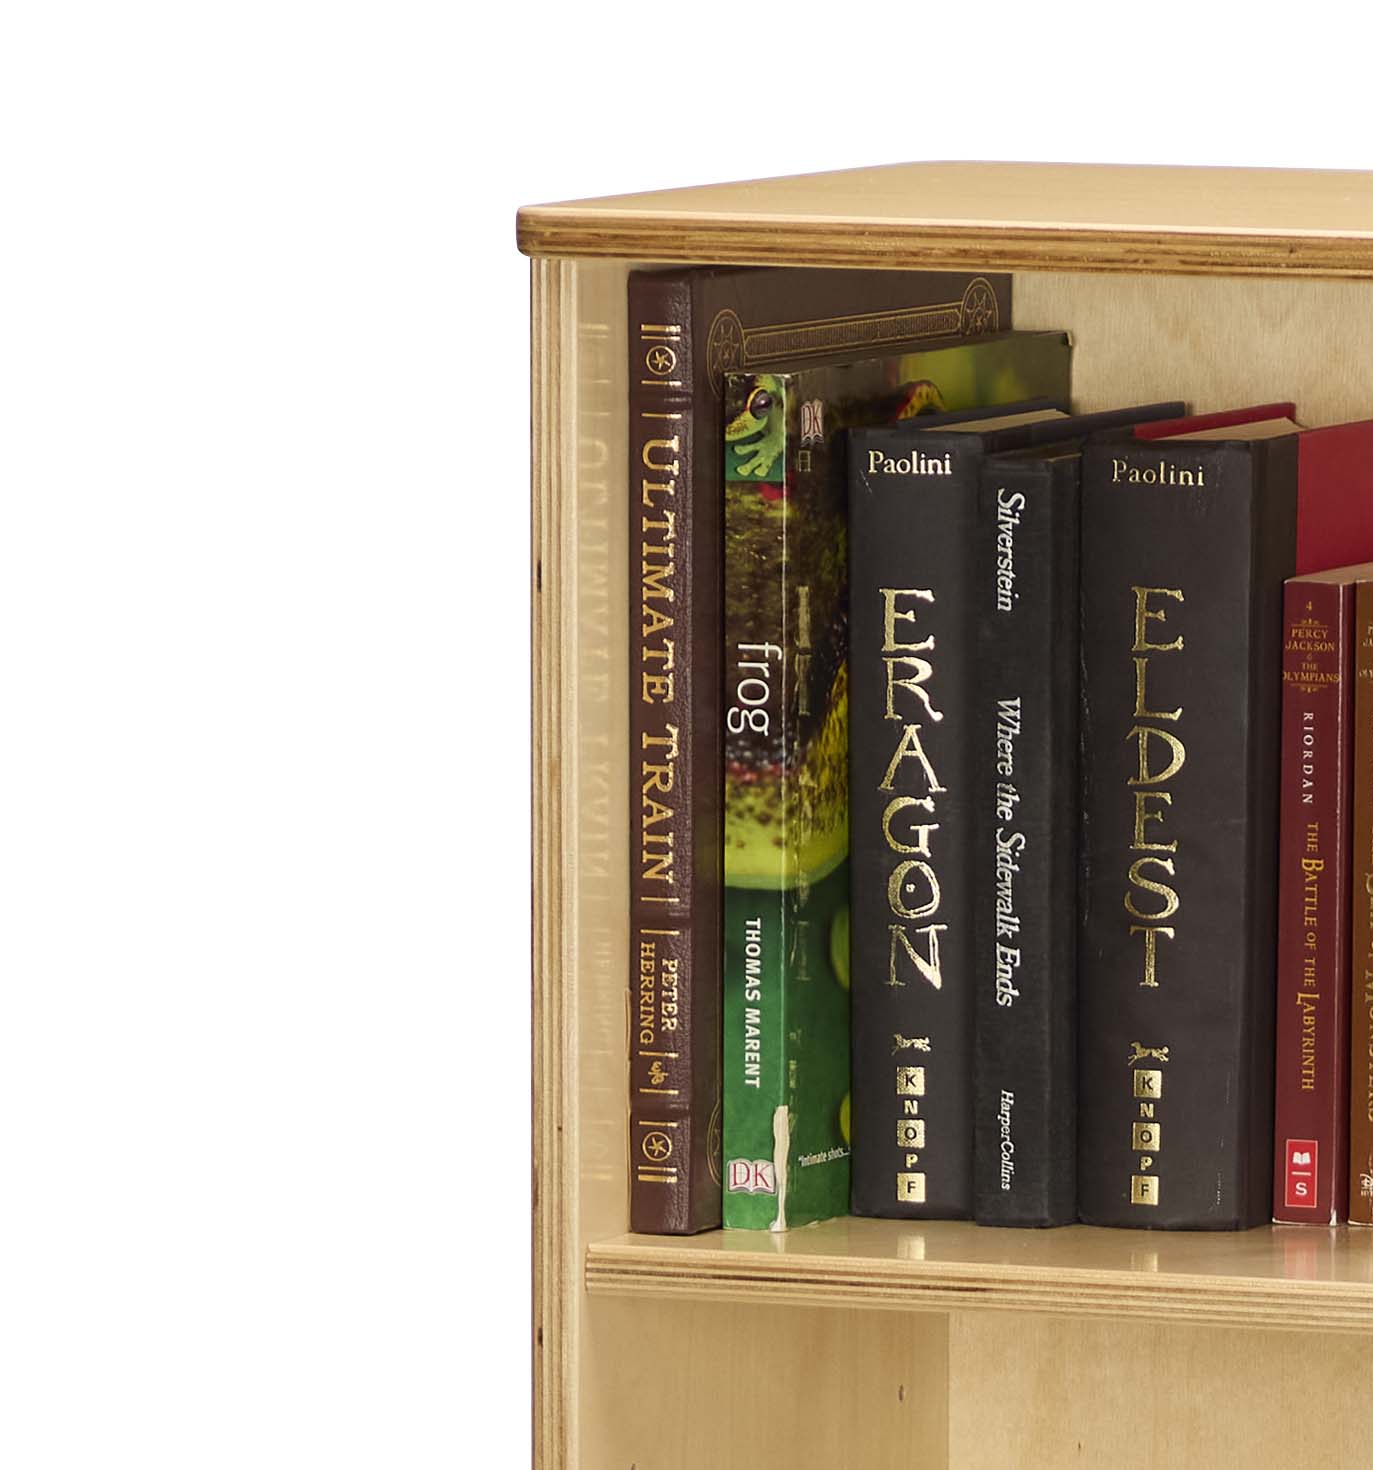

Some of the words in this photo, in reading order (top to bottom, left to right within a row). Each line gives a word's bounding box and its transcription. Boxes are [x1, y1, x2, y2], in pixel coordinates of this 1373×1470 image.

[868, 450, 953, 476] Paolini
[1112, 458, 1206, 488] Paolini
[641, 435, 679, 705] ULTIMATE
[997, 488, 1026, 613] Silverstein
[1285, 640, 1335, 652] JACKSON
[1291, 628, 1329, 639] PERCY
[726, 641, 783, 736] frog
[997, 696, 1021, 777] Where
[1302, 711, 1315, 805] RIORDAN
[641, 721, 679, 886] TRAIN
[877, 586, 948, 990] ERAGON
[997, 782, 1020, 820] the
[1124, 586, 1187, 989] ELDEST
[1307, 822, 1319, 853] THE
[996, 827, 1026, 938] Sidewalk
[744, 917, 761, 1001] THOMAS
[996, 943, 1021, 1008] Ends
[1304, 931, 1316, 950] OF
[1304, 957, 1316, 987] THE
[638, 942, 656, 1045] HERRING
[660, 959, 679, 1032] PETER
[744, 1007, 761, 1088] MARENT
[731, 1161, 772, 1188] DK
[896, 1066, 927, 1203] KNOPF
[999, 1089, 1016, 1191] HarperCollins
[1131, 1069, 1163, 1206] KNOPF
